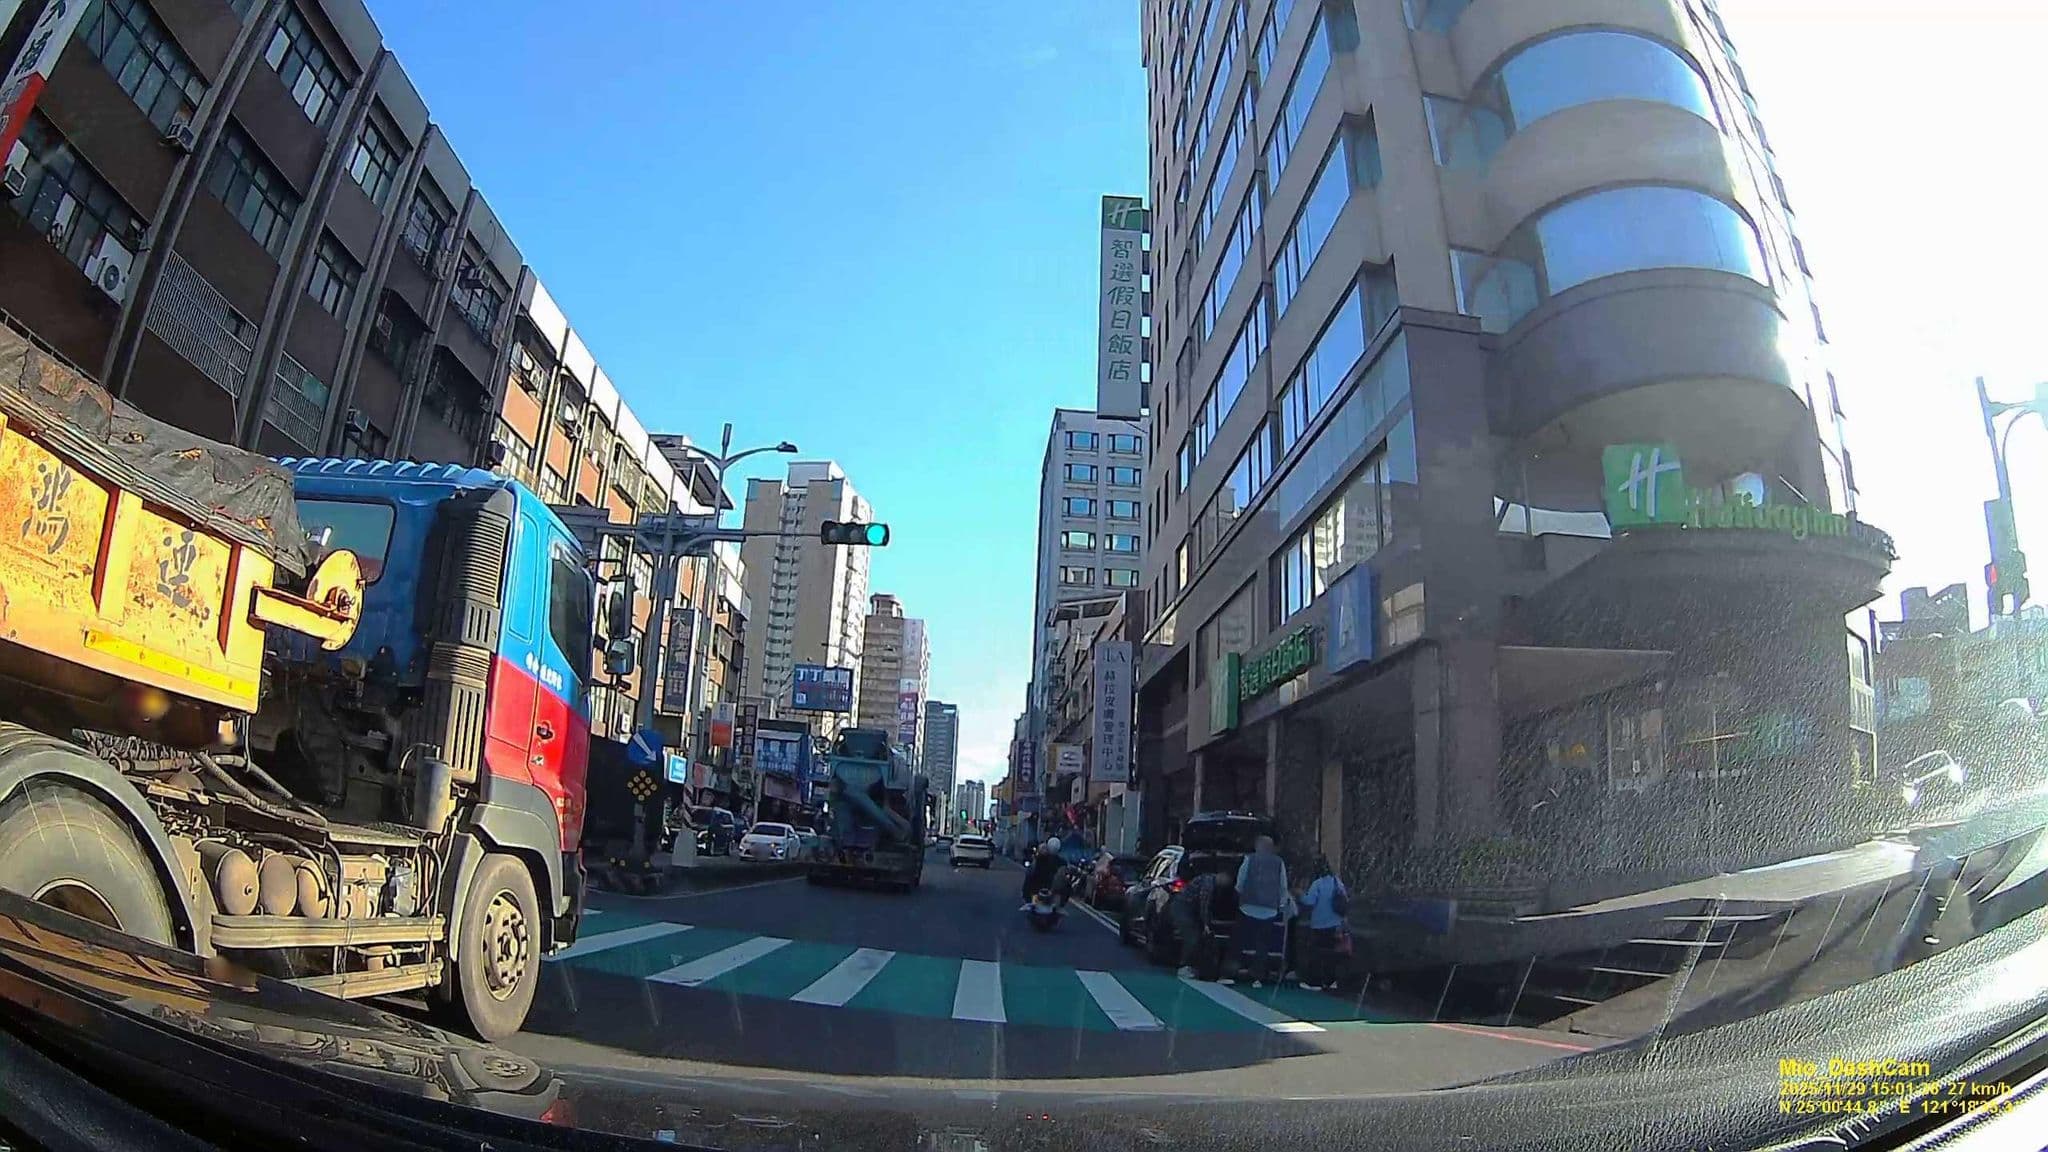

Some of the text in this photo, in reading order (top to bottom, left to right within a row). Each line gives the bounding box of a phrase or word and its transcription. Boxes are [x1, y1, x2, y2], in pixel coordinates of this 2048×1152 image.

[1107, 239, 1135, 381] 智選假日飯店
